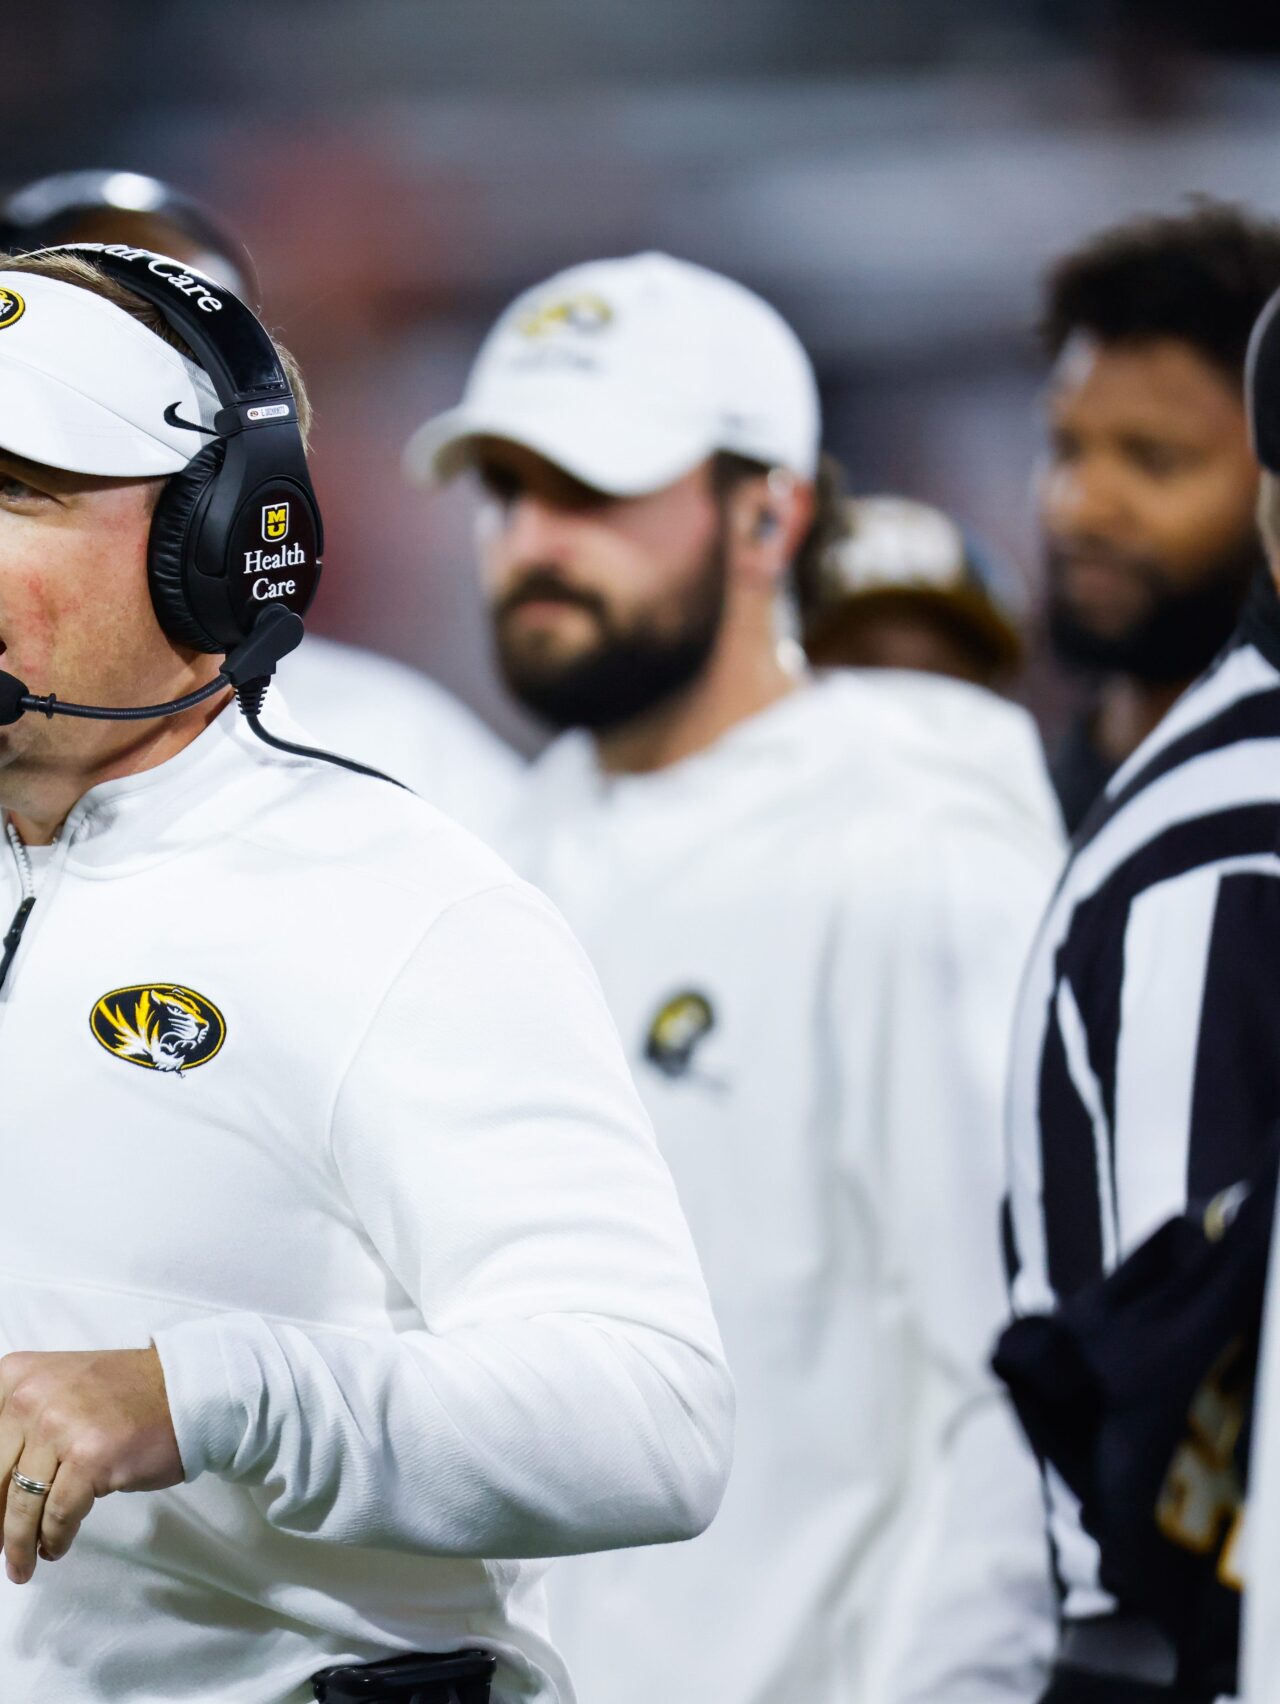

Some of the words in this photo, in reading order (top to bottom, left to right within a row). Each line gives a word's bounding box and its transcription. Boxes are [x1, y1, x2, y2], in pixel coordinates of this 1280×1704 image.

[147, 256, 223, 313] Care
[243, 541, 306, 574] Health
[252, 577, 296, 600] Care
